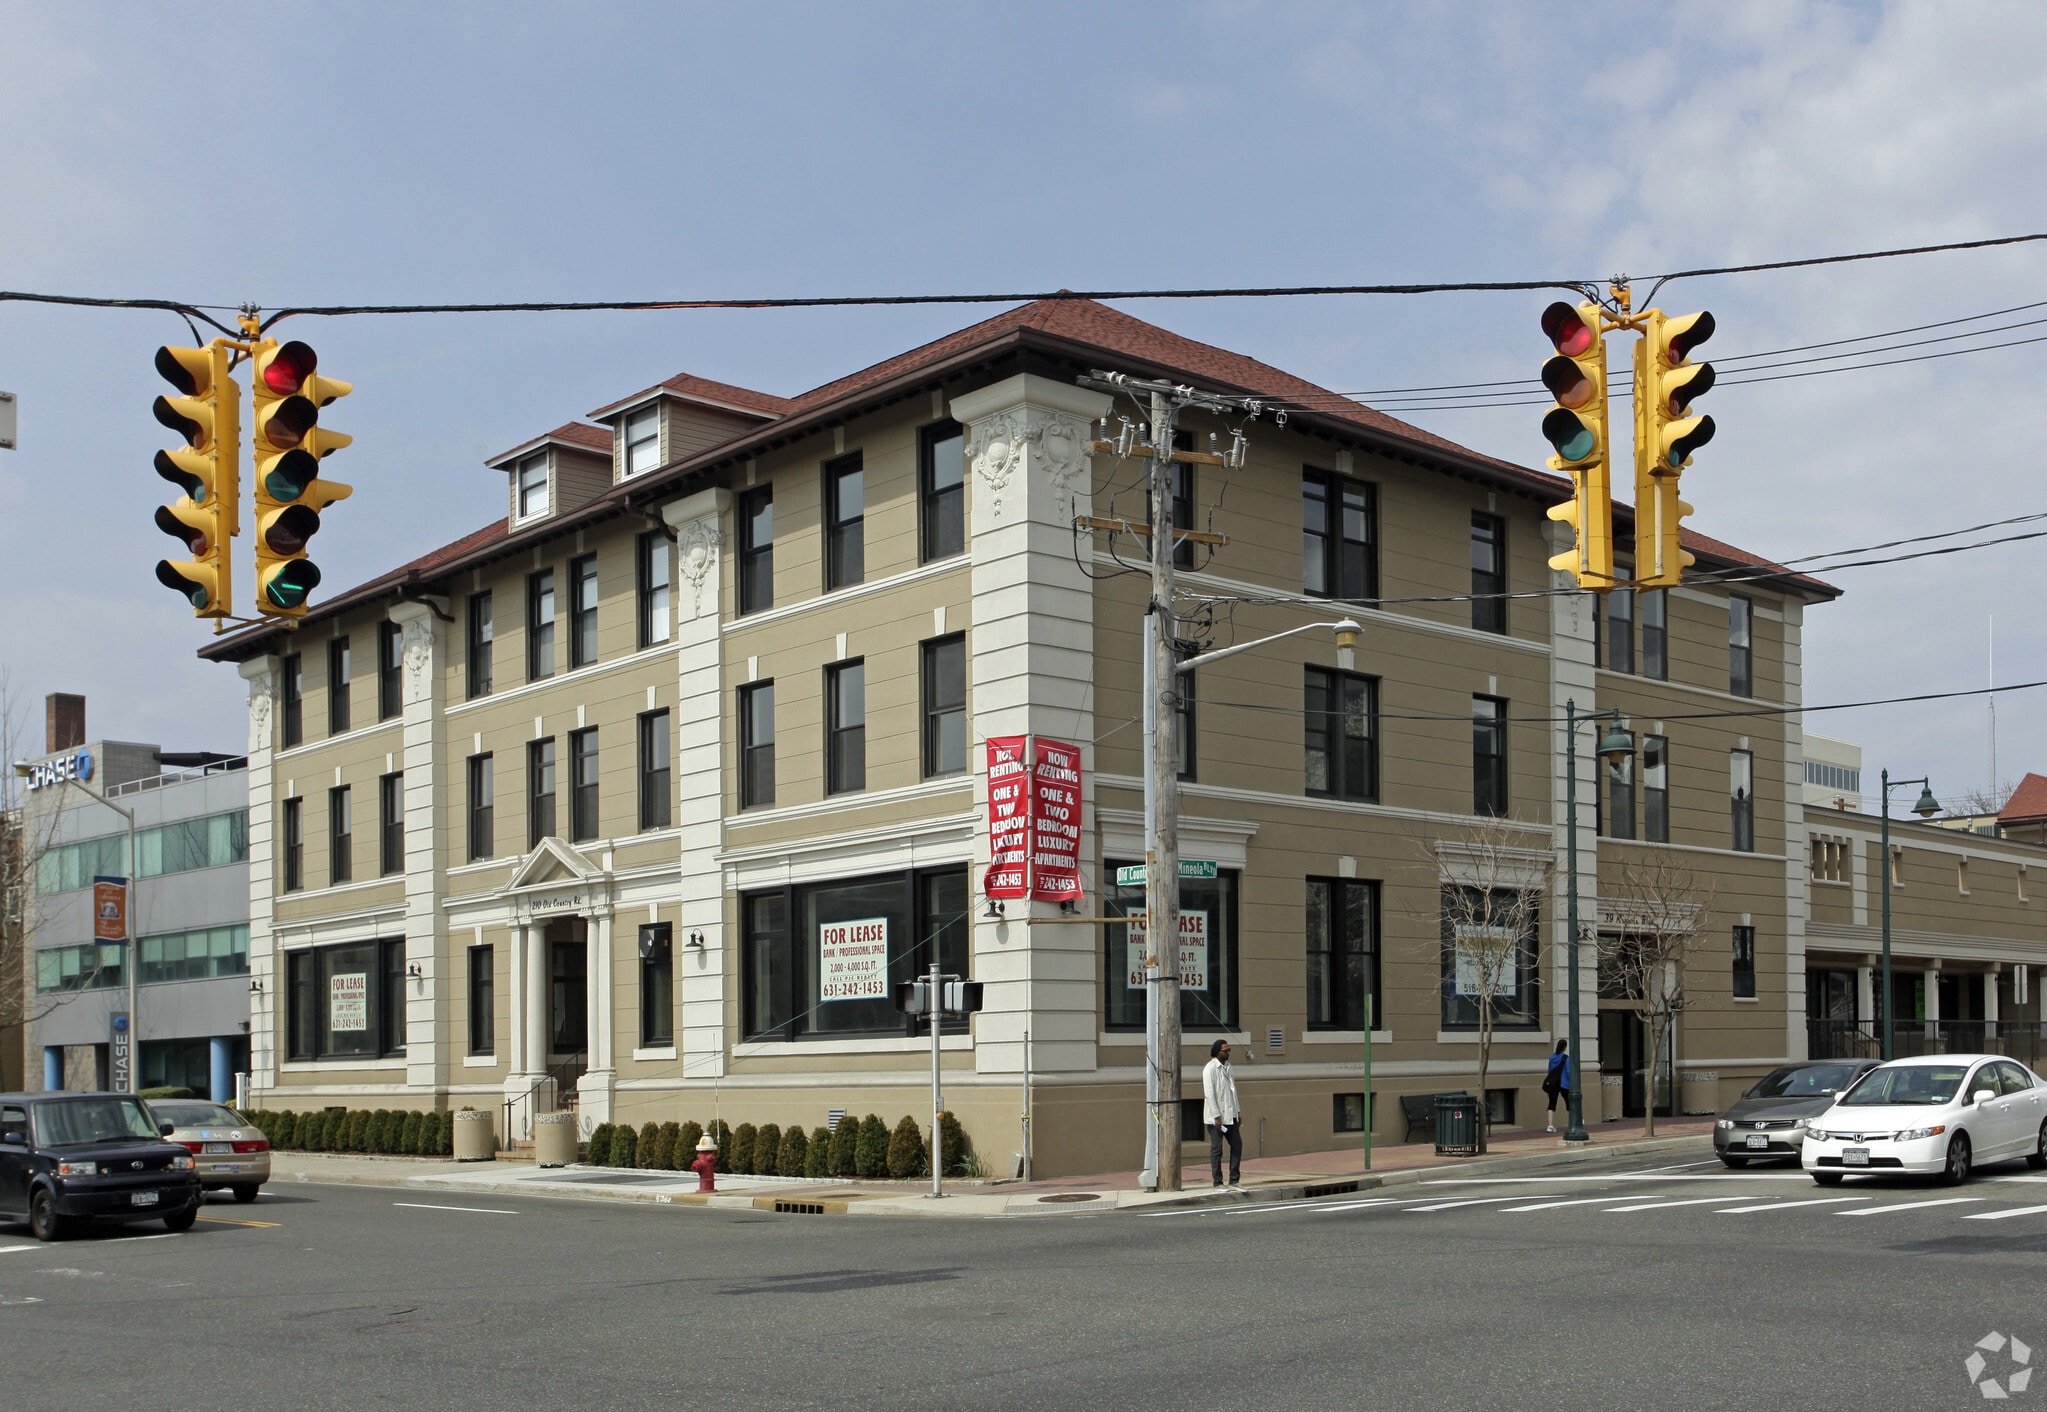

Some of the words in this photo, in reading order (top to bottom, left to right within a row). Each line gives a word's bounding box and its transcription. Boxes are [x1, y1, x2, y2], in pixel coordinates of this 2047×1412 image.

[1047, 751, 1069, 767] NOW
[26, 754, 77, 790] CHASE
[989, 761, 1024, 779] RENTING
[1036, 762, 1078, 783] RENTING
[993, 786, 1012, 801] ONE
[1013, 784, 1019, 797] &
[1040, 787, 1063, 803] ONE
[1065, 792, 1075, 806] &
[1044, 803, 1070, 821] TWO
[1037, 818, 1078, 839] BEDROOM
[993, 833, 1024, 851] LURY
[1037, 835, 1076, 852] LUXURY
[1034, 852, 1076, 869] APARTMENTS
[1177, 861, 1203, 876] Mineola
[1118, 868, 1128, 881] Old
[1043, 877, 1076, 890] 242-1453
[542, 899, 552, 909] Old
[553, 898, 572, 908] Country
[1131, 913, 1147, 930] FO
[1179, 915, 1203, 933] ASE
[1605, 912, 1614, 923] 39
[824, 928, 846, 945] FOR
[850, 924, 883, 943] LEASE
[1130, 934, 1145, 944] BANK
[1189, 937, 1205, 947] SPACE
[823, 948, 835, 958] BANK
[839, 945, 871, 957] PROFESSIONAL
[871, 944, 885, 955] SPACE
[830, 963, 843, 973] 2,000
[847, 962, 860, 972] 4,000
[333, 978, 345, 990] FOR
[346, 977, 364, 990] LEASE
[823, 981, 883, 996] 631-242-1453
[115, 1034, 128, 1092] CHASE
